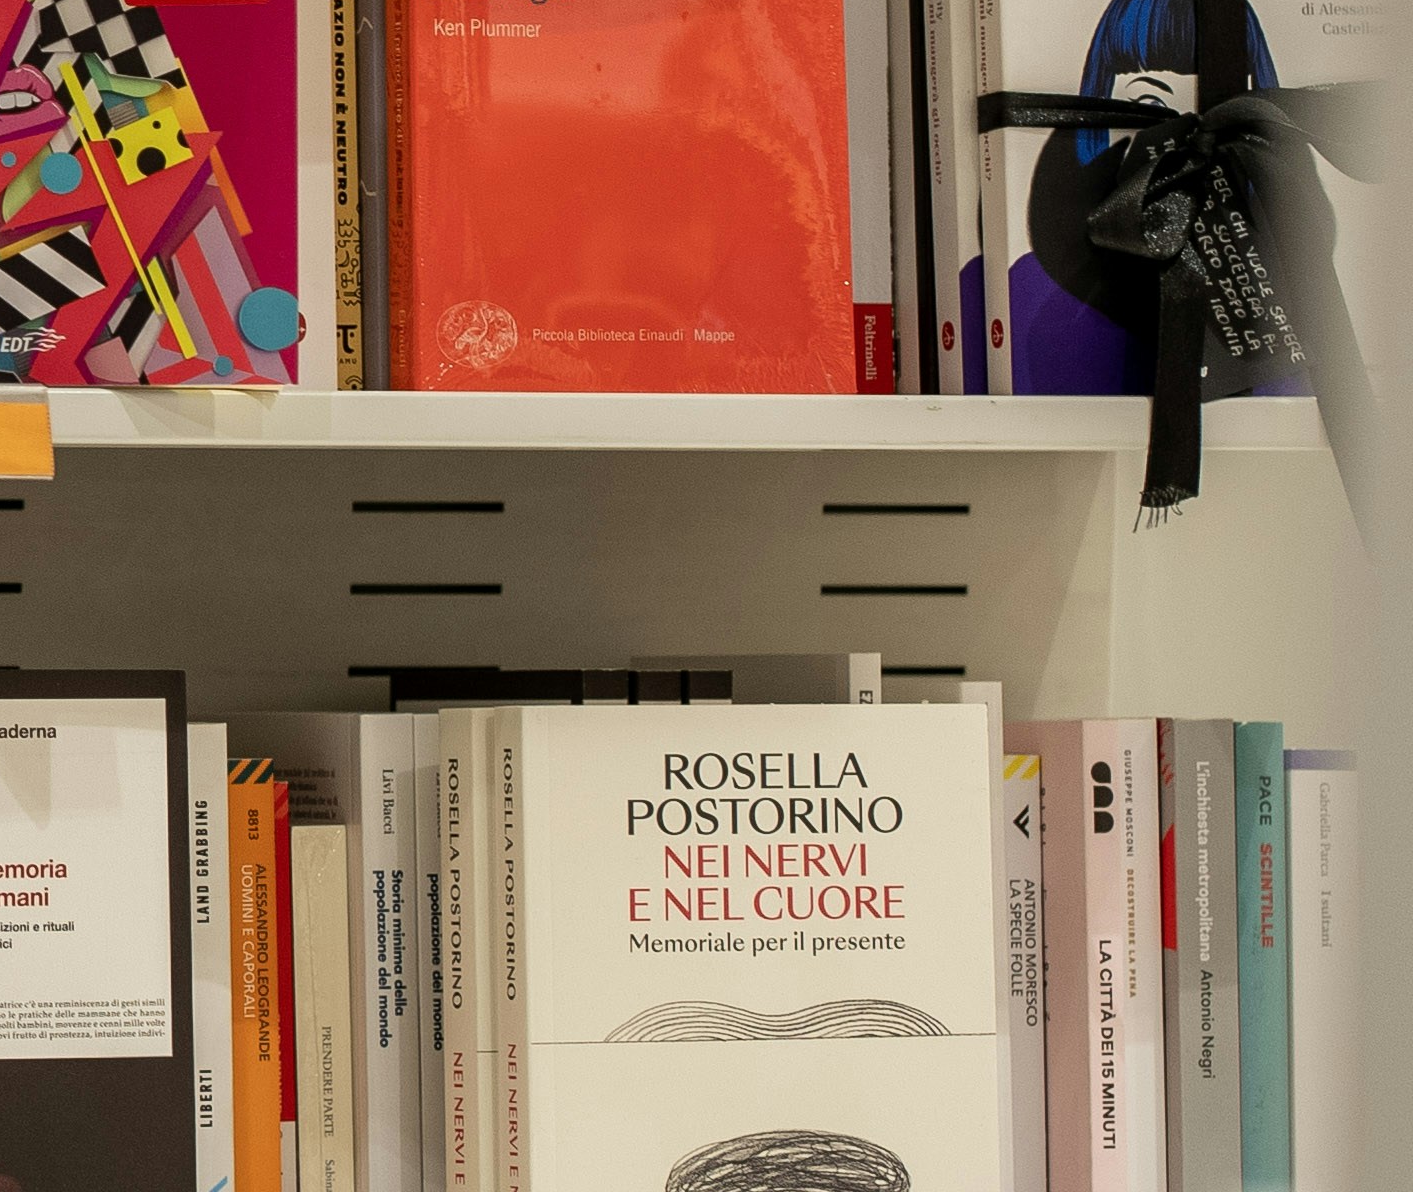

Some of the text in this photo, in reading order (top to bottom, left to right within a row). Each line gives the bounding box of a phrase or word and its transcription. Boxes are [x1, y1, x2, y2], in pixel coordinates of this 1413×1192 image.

[434, 18, 542, 38] Ken Plummer
[664, 752, 868, 790] ROSELLA
[627, 796, 903, 836] POSTORINO
[664, 843, 867, 879] NEI NERVI
[1195, 761, 1212, 962] L'inchiesta metropolitana
[629, 885, 905, 922] E NEL CUORE
[33, 923, 40, 932] e
[43, 921, 75, 932] rituali
[629, 931, 906, 957] Memoriale per il presente
